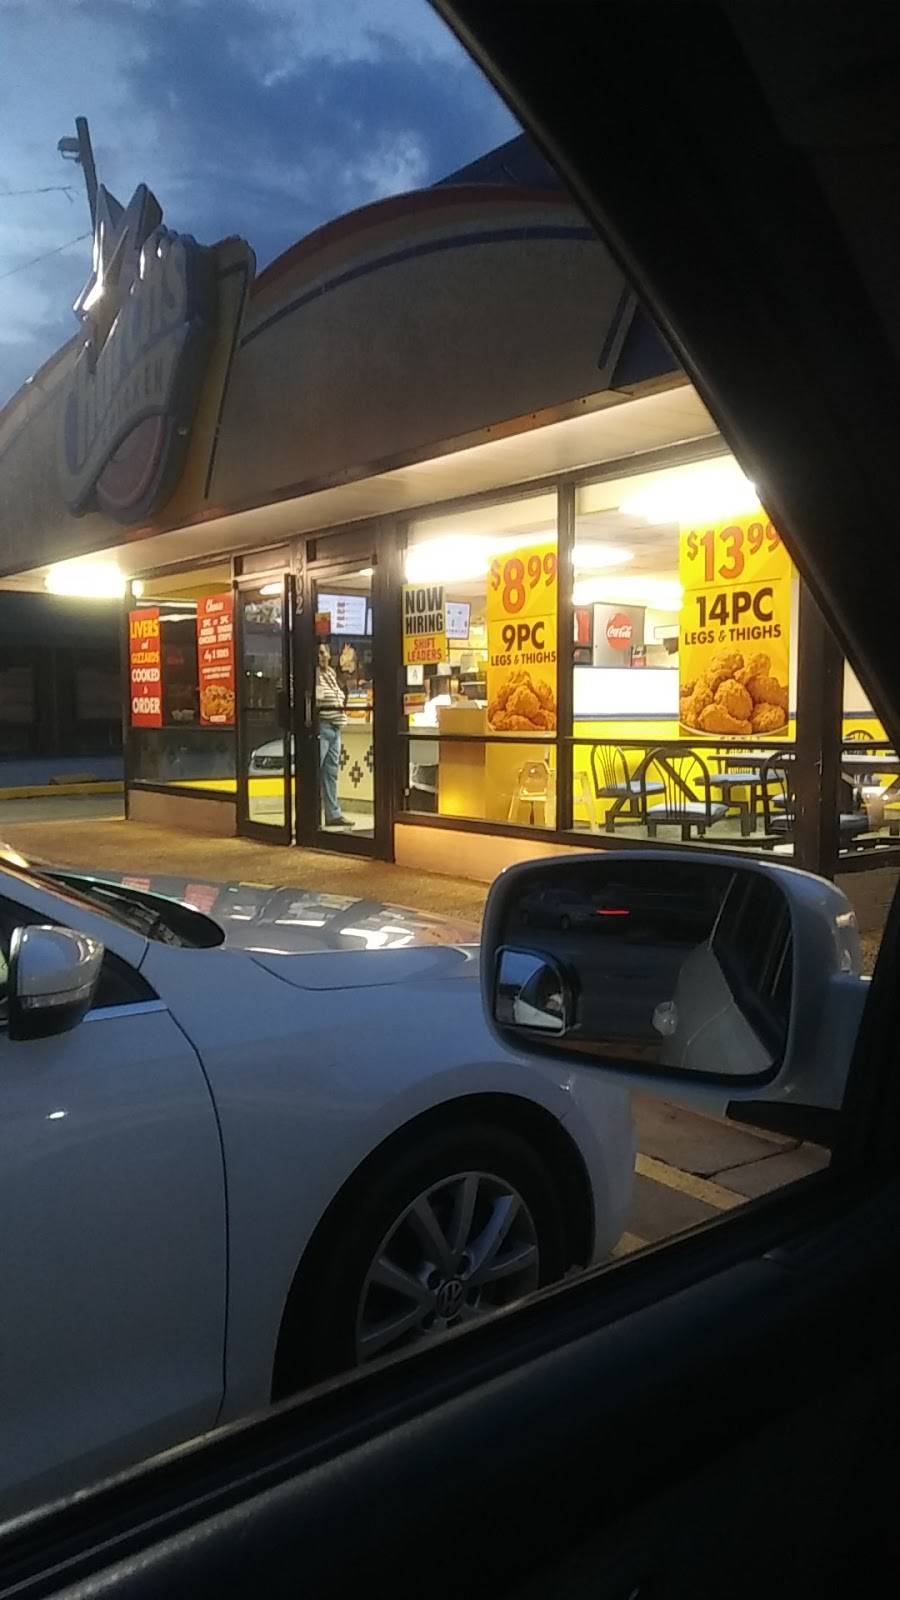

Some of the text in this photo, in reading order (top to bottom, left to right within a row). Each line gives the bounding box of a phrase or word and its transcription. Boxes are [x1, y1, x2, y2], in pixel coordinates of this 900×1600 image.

[405, 586, 444, 615] NOW
[696, 587, 774, 628] 14PC
[130, 619, 159, 639] LIVERS
[405, 612, 444, 635] HIRING
[414, 637, 436, 651] SHIFT
[501, 621, 545, 652] 9PC
[684, 624, 782, 646] LEGS & THIGHS
[407, 648, 442, 663] LEADERS
[490, 651, 557, 667] LEGS & THIGHS
[131, 668, 160, 684] COOKED
[132, 696, 160, 714] ORDER
